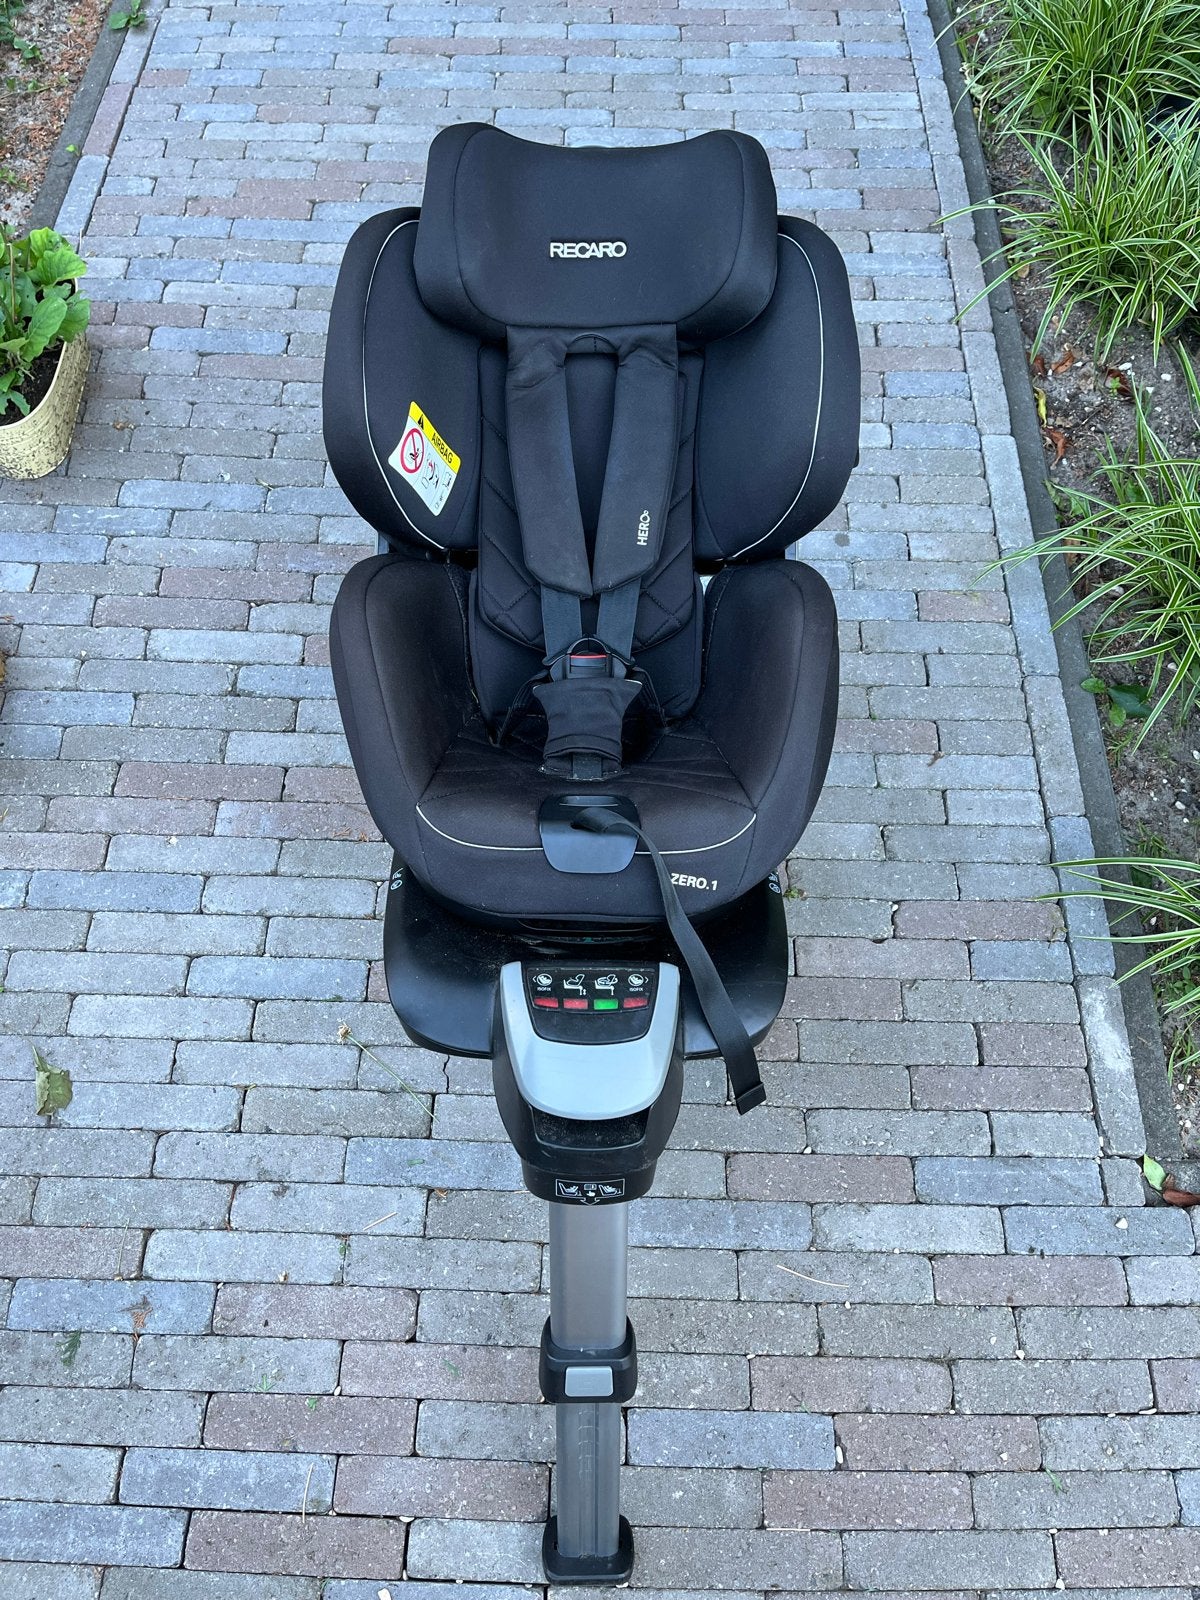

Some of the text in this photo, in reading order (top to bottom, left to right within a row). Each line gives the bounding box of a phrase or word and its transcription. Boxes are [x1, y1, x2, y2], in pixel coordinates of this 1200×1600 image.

[549, 241, 627, 258] RECARO
[431, 432, 454, 464] AIRBAG
[636, 513, 650, 546] HERO
[670, 872, 718, 891] ZERO.1
